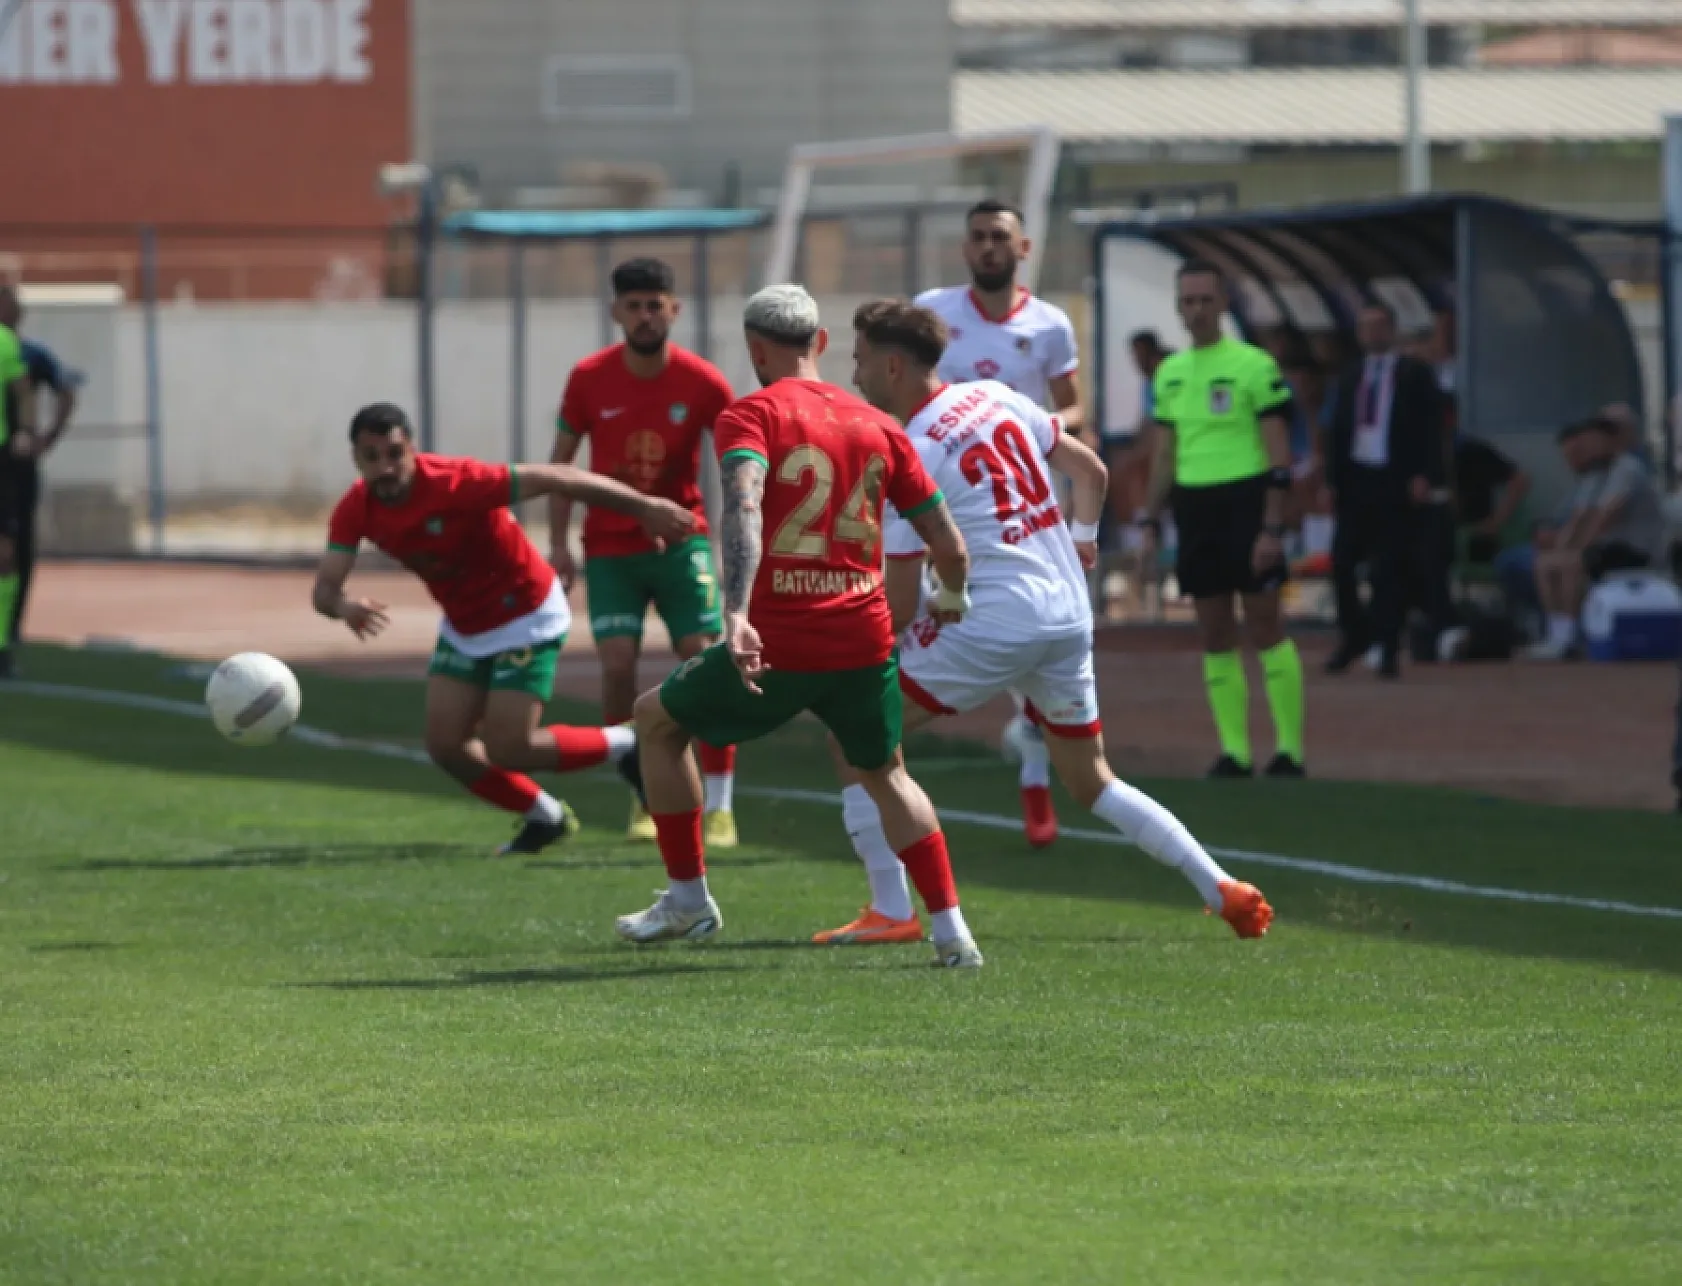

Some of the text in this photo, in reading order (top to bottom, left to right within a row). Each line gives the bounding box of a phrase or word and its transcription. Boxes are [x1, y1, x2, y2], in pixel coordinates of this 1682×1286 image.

[134, 0, 374, 82] YERDE
[769, 444, 886, 562] 24
[960, 420, 1049, 521] 20
